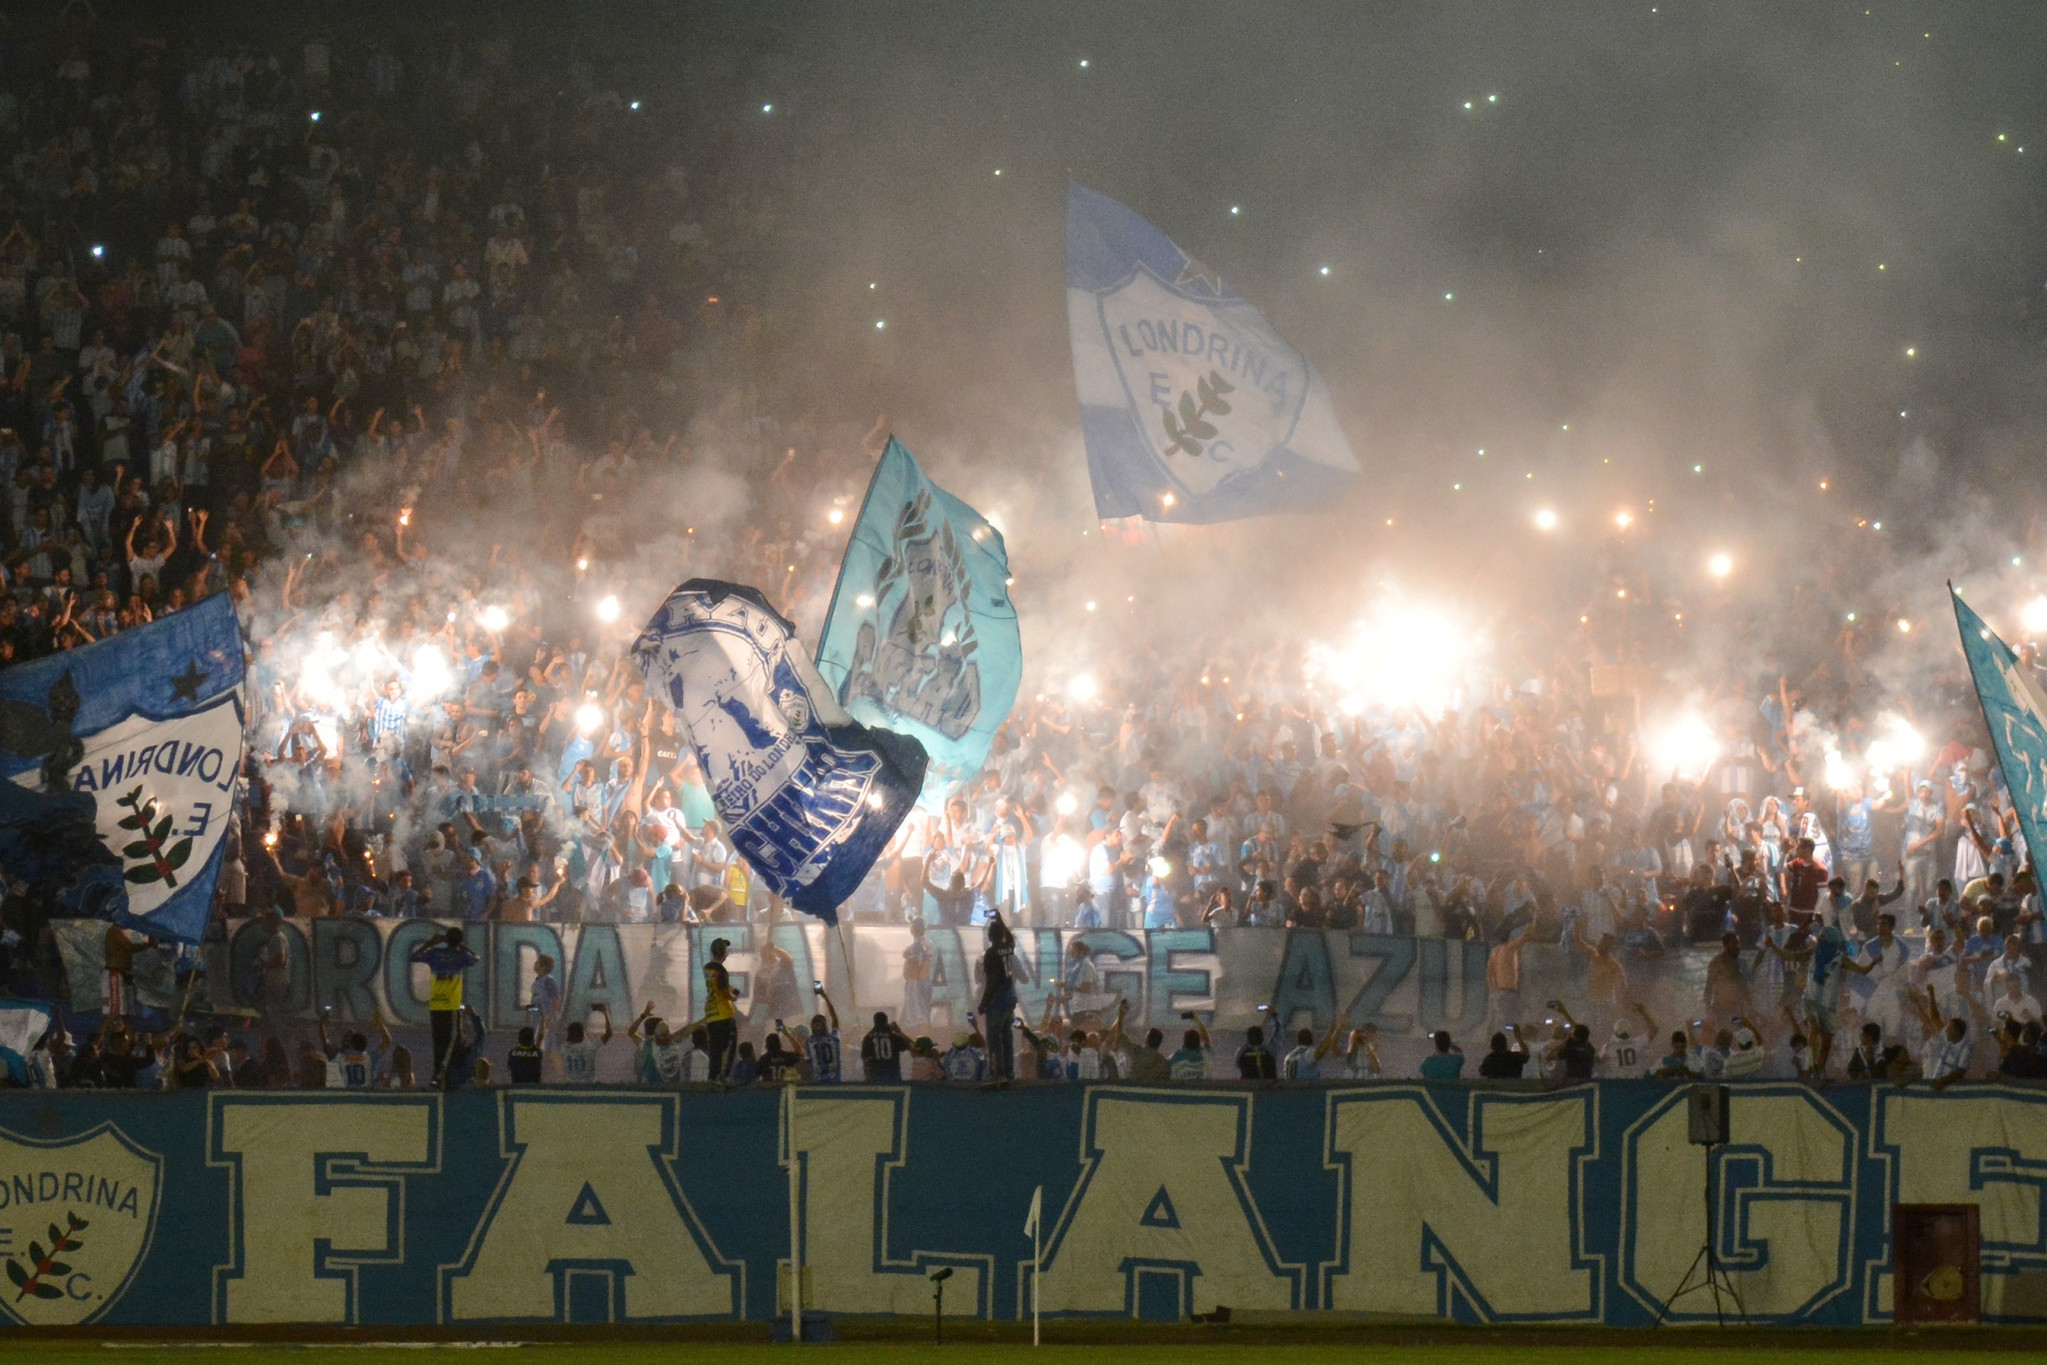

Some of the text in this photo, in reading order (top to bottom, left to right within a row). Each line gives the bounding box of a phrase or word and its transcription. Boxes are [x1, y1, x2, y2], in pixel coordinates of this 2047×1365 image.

[1119, 319, 1288, 409] LONDRINA
[1149, 371, 1172, 408] E
[1208, 440, 1236, 463] C
[748, 765, 768, 783] DO
[203, 916, 637, 1031] ORCIDA
[1271, 927, 1490, 1038] AZU
[871, 1037, 893, 1060] 10
[1617, 1047, 1637, 1067] 10
[0, 1171, 139, 1219] ONDRINA
[204, 1082, 2047, 1327] FALANGE
